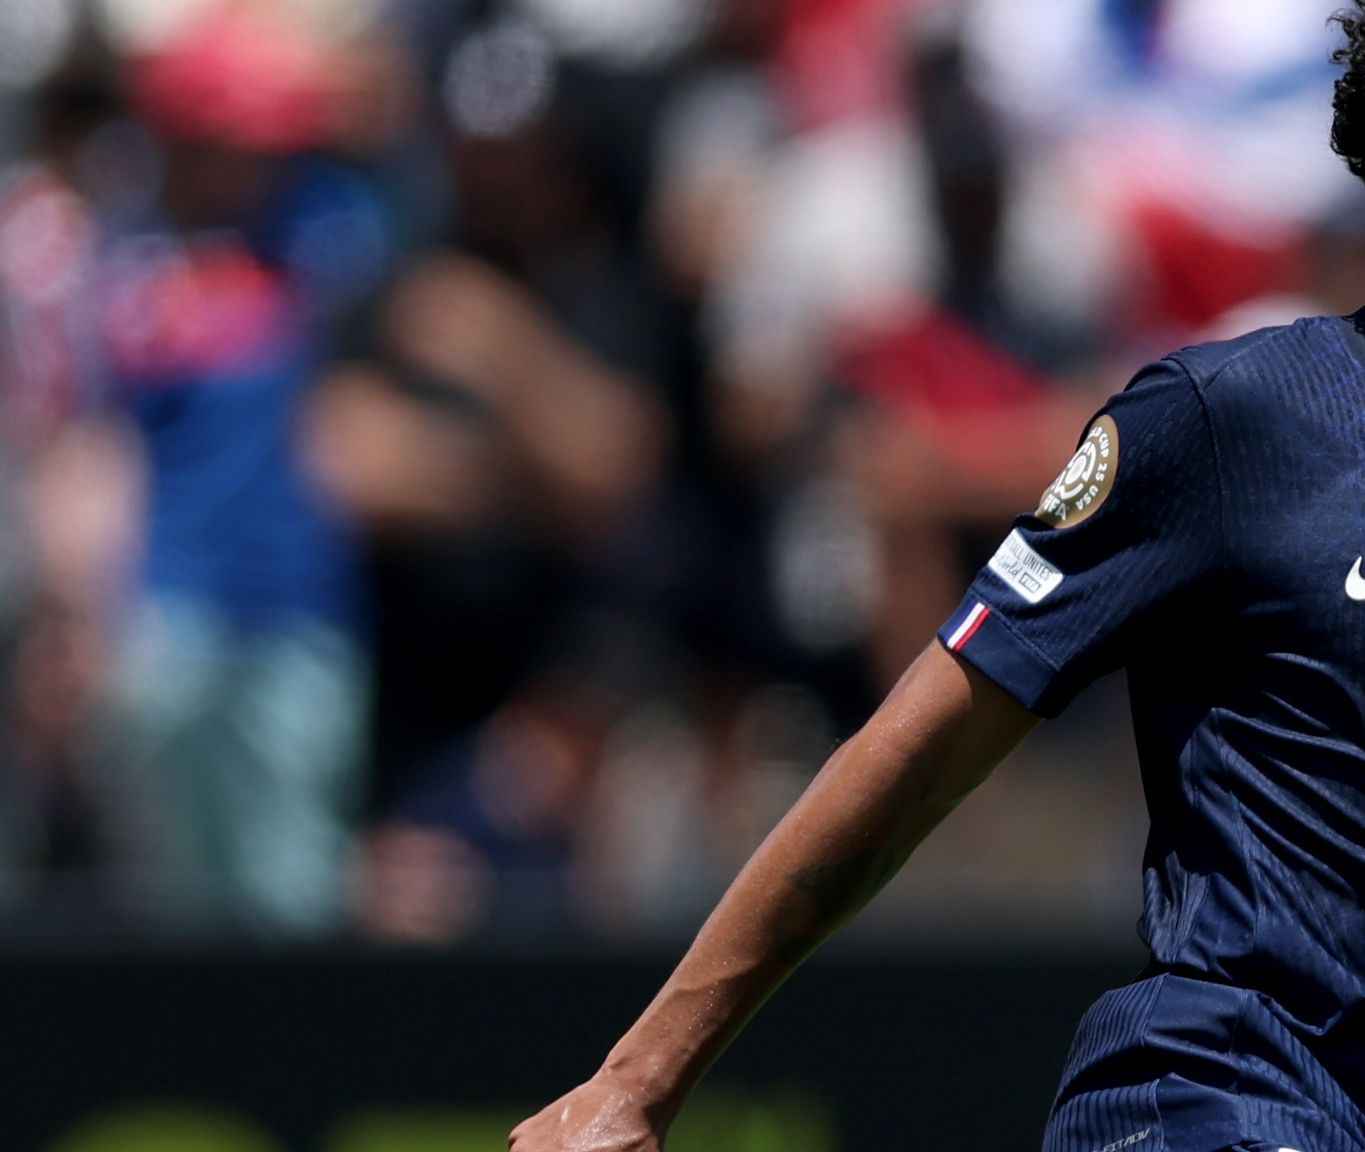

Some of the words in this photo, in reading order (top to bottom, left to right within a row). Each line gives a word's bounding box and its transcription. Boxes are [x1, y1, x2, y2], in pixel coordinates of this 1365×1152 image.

[1099, 432, 1110, 458] CUP
[1095, 463, 1108, 482] 25
[1075, 485, 1099, 511] USA
